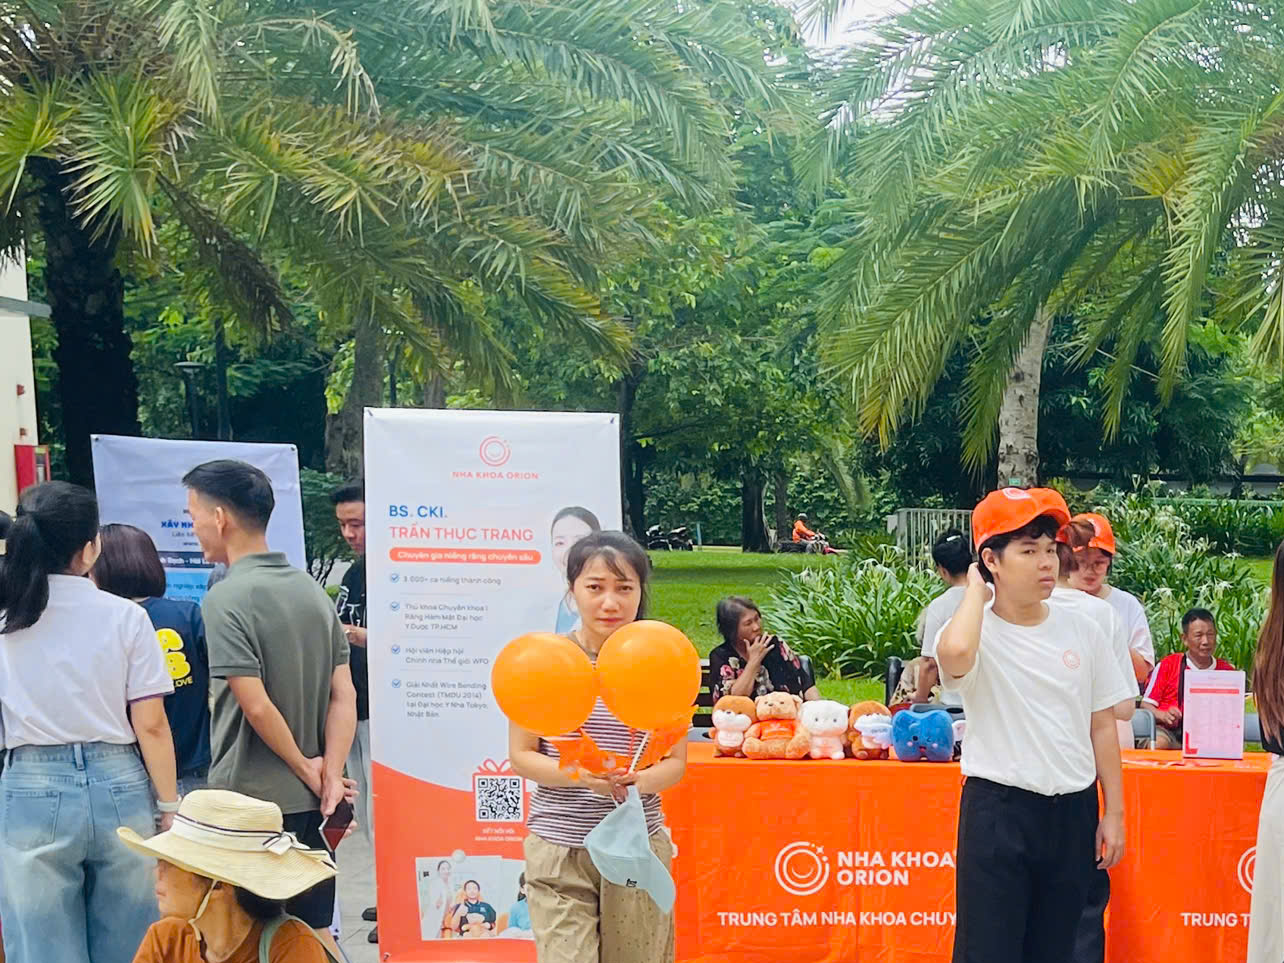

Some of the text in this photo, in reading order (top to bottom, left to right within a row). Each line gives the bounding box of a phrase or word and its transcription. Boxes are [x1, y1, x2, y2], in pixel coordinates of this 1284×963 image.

[452, 471, 539, 480] NHA KHOA ORION
[481, 528, 534, 541] TRANG
[837, 851, 956, 868] NHA KHOA
[837, 869, 909, 886] ORION
[717, 911, 778, 927] TRUNG
[780, 908, 817, 926] TÂM
[821, 911, 857, 926] NHA
[859, 911, 907, 926] KHOA
[1179, 912, 1238, 927] TRUNG
